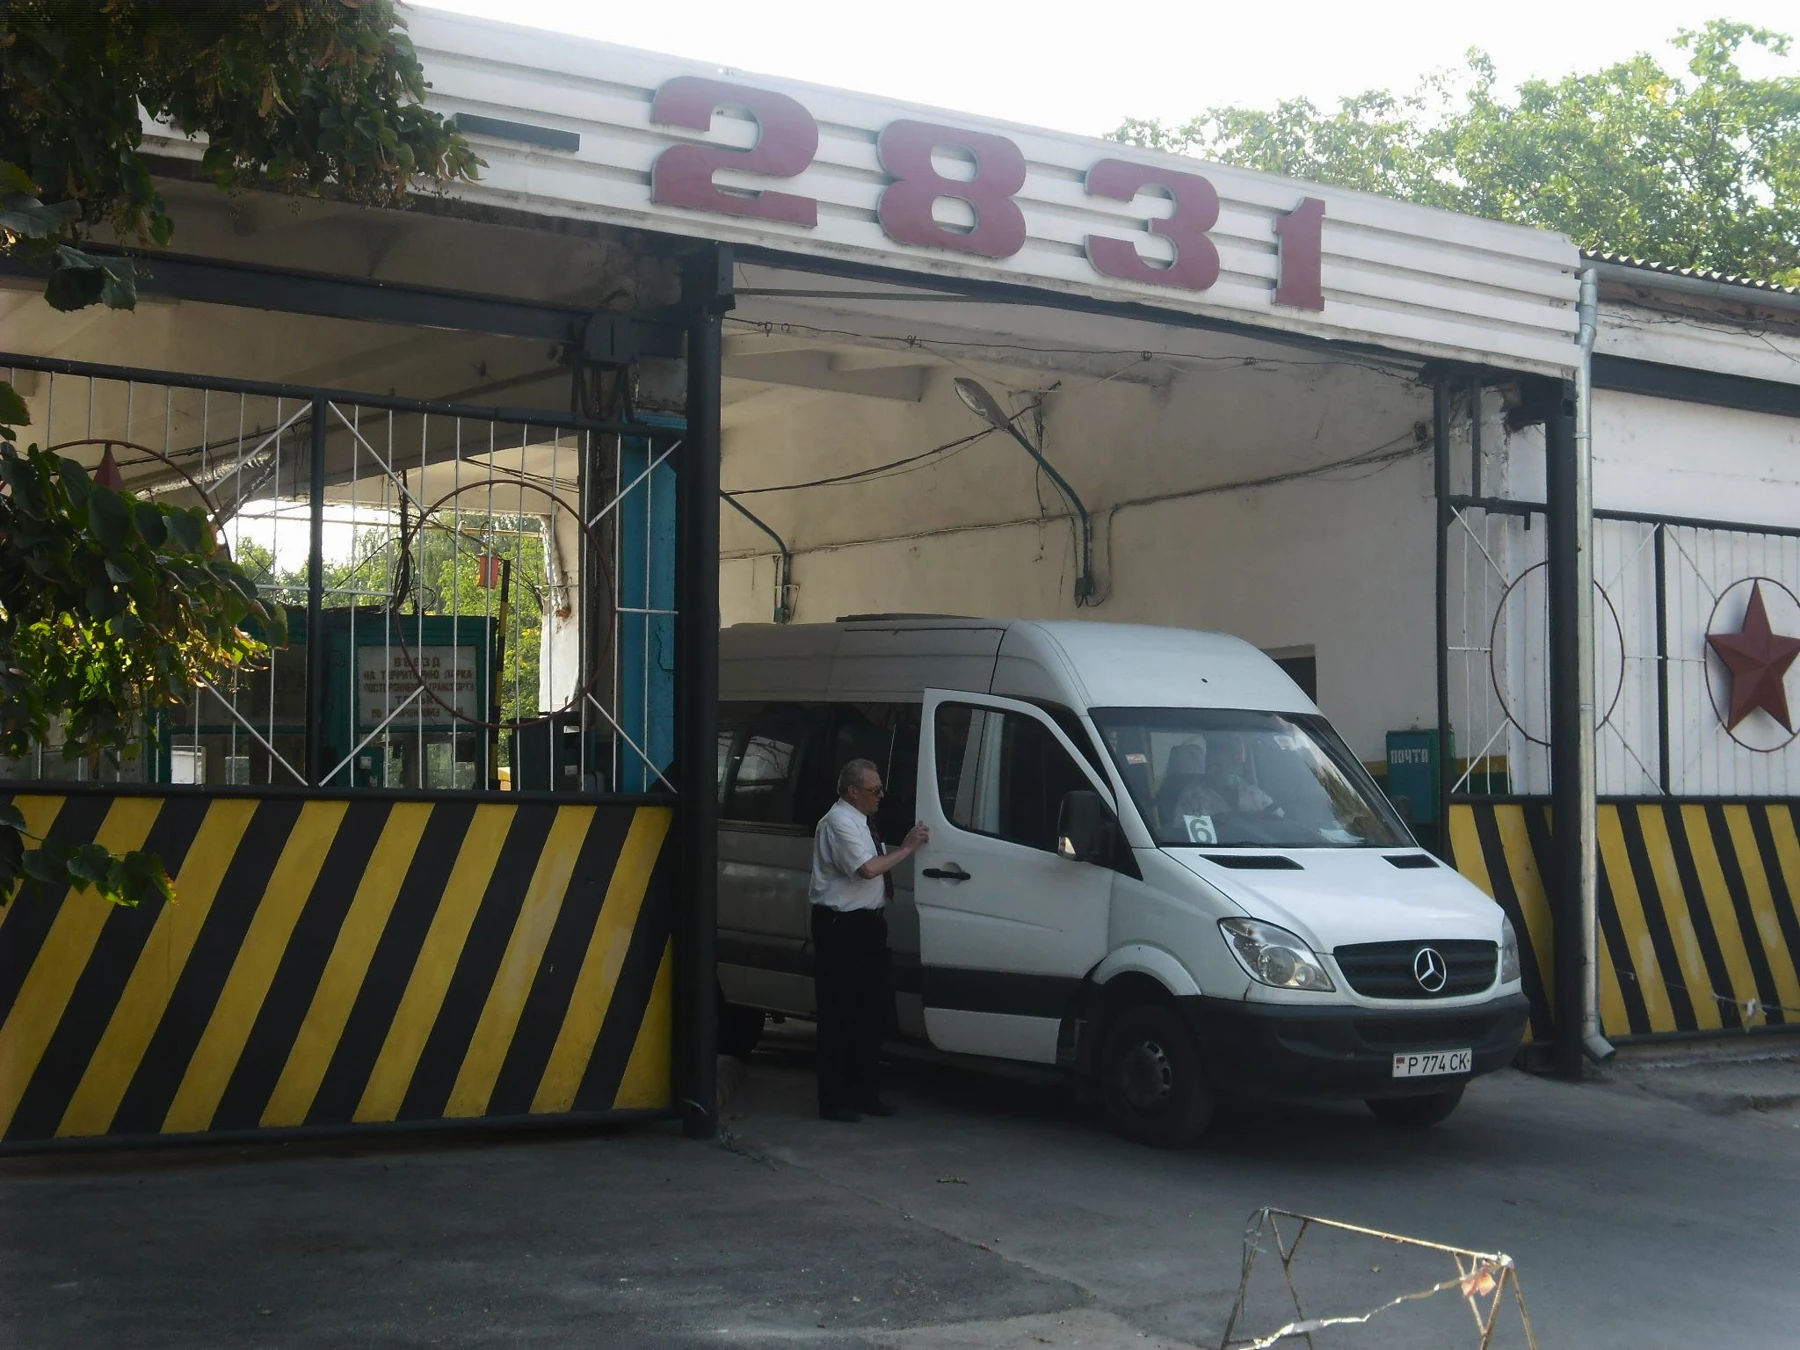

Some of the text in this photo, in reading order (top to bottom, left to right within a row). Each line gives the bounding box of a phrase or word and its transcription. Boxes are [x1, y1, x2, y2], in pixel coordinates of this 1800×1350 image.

[651, 75, 1326, 312] 2831
[1390, 749, 1428, 763] ПОЧТА
[1190, 819, 1212, 843] 6
[1422, 1055, 1446, 1073] 774
